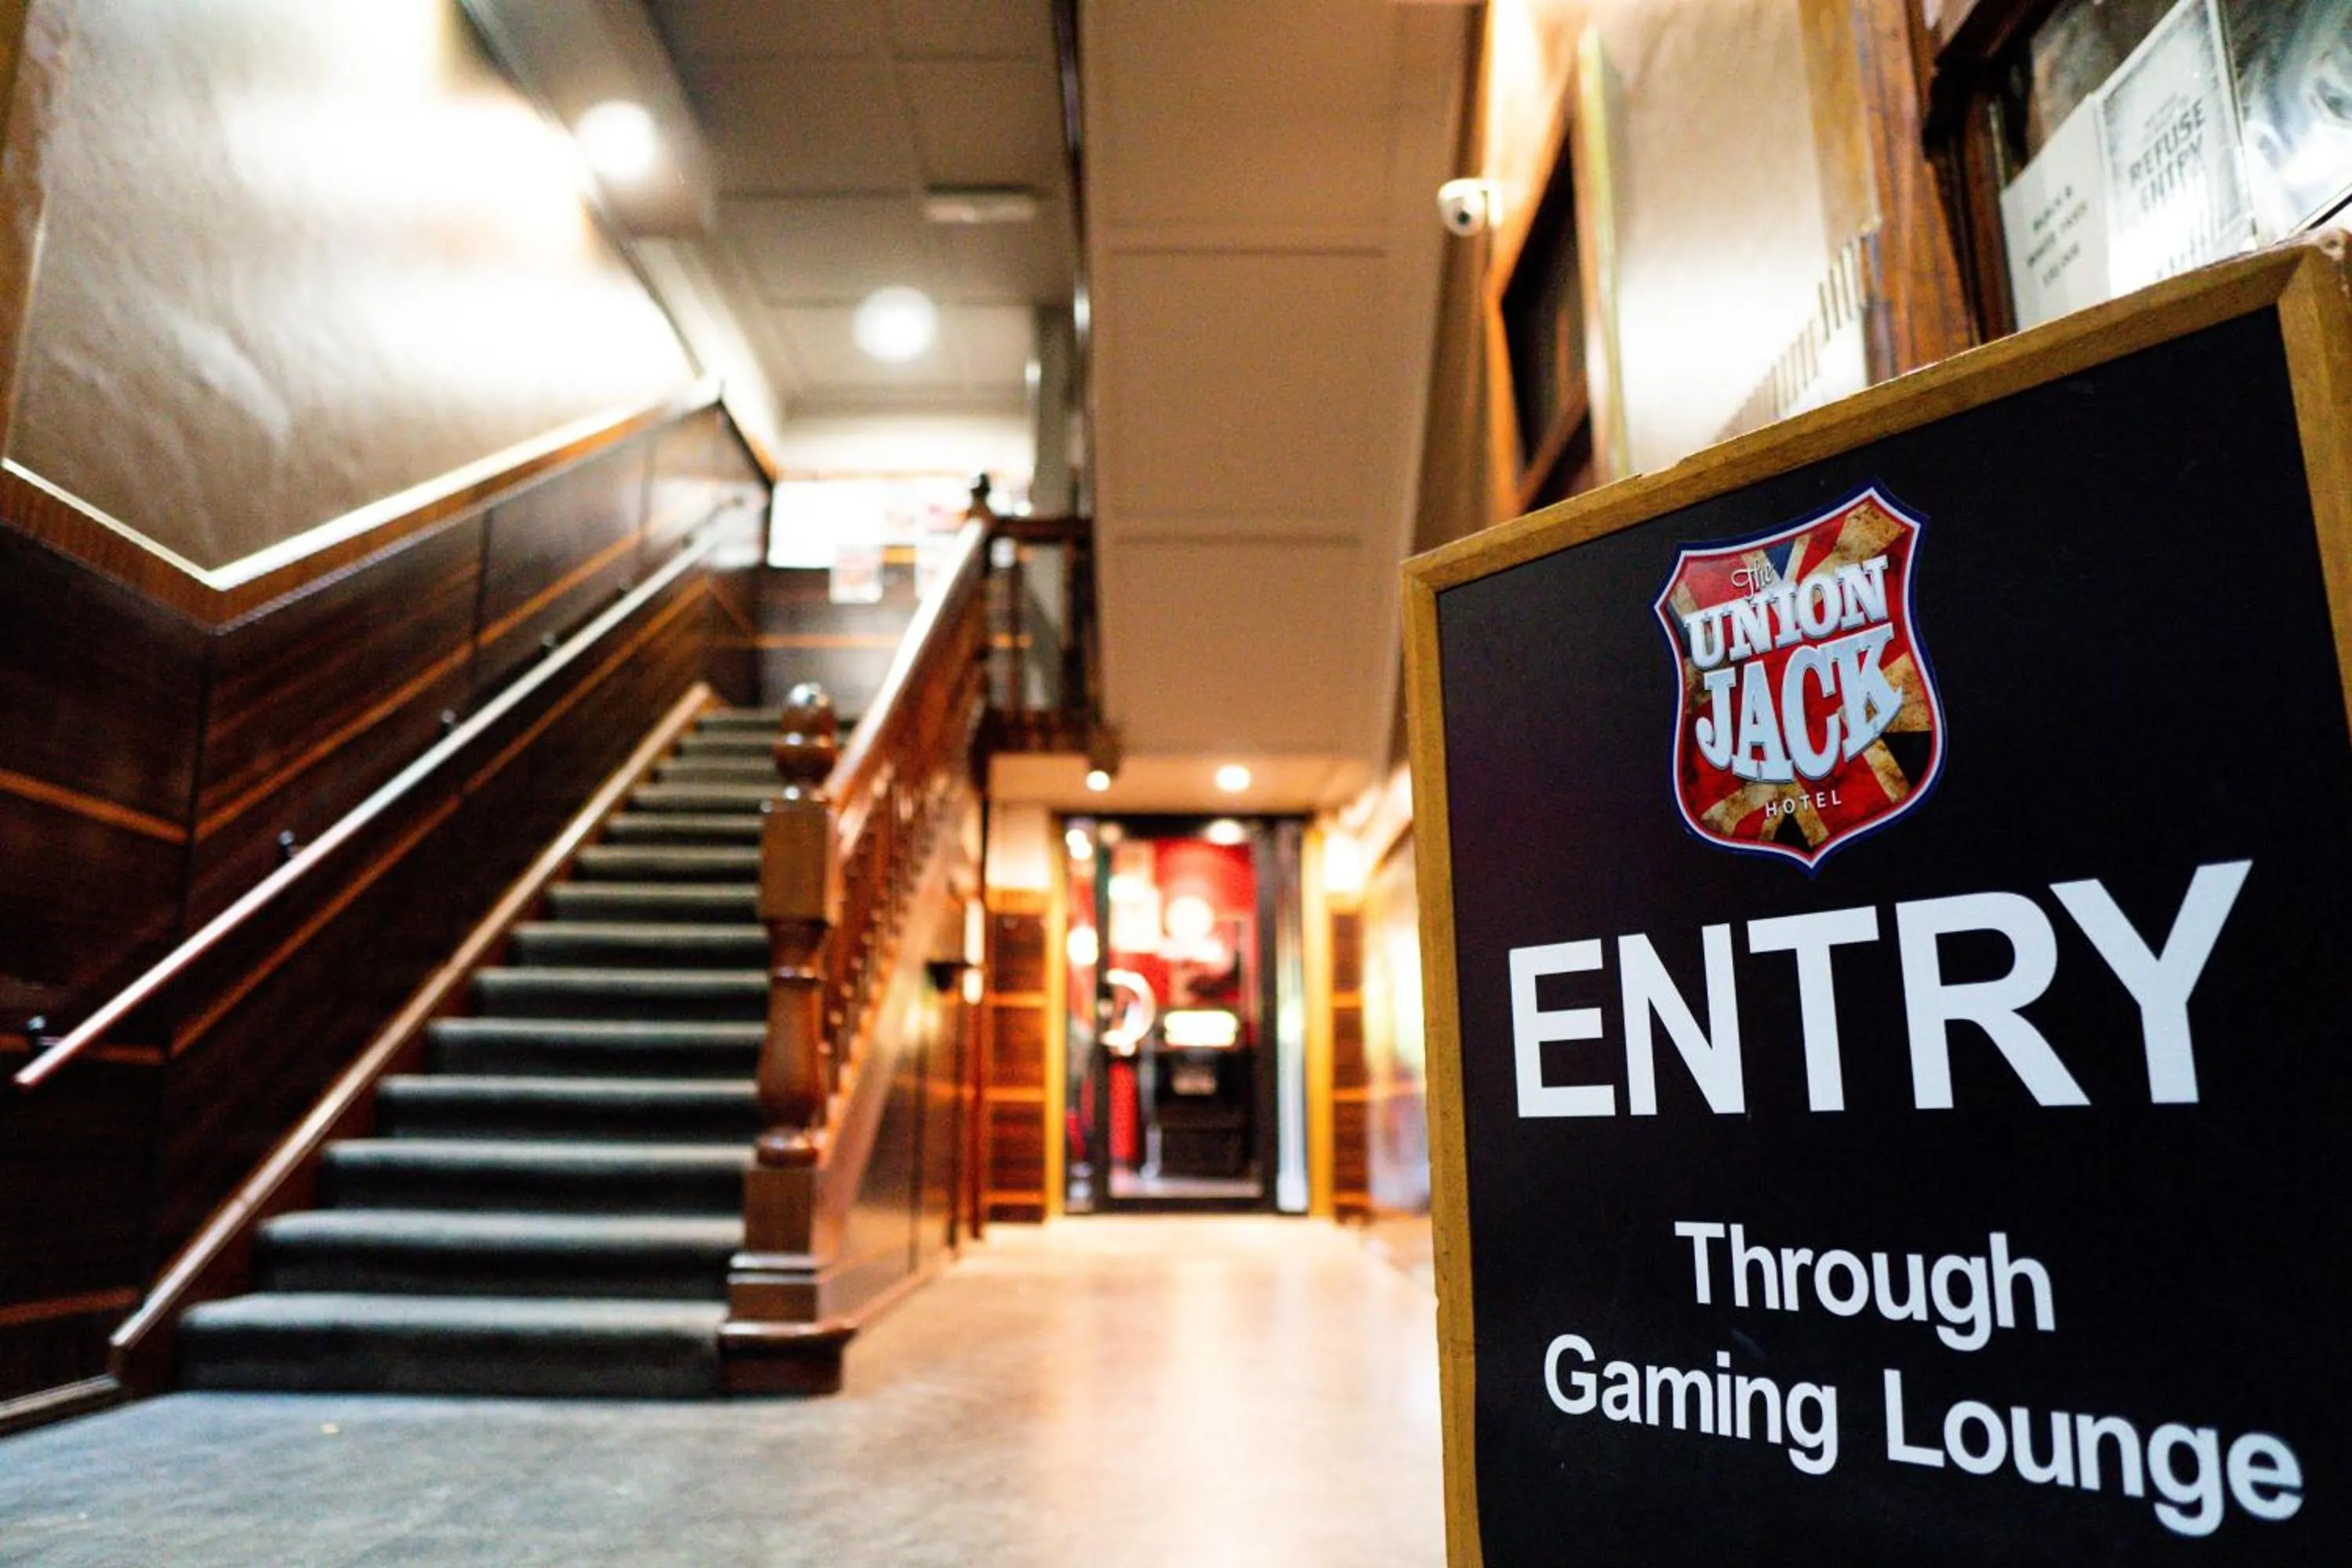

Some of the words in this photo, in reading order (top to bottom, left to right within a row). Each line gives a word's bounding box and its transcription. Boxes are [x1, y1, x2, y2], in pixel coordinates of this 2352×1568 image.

[2130, 97, 2206, 187] REFUSE
[1683, 555, 1889, 671] UNION
[1731, 558, 1777, 598] The
[1695, 623, 1904, 784] JACK
[1765, 789, 1842, 818] HOTEL
[1508, 859, 2252, 1118] ENTRY
[1674, 1221, 2055, 1352] Through
[1544, 1334, 1838, 1475] Gaming
[1883, 1368, 2303, 1537] Lounge
